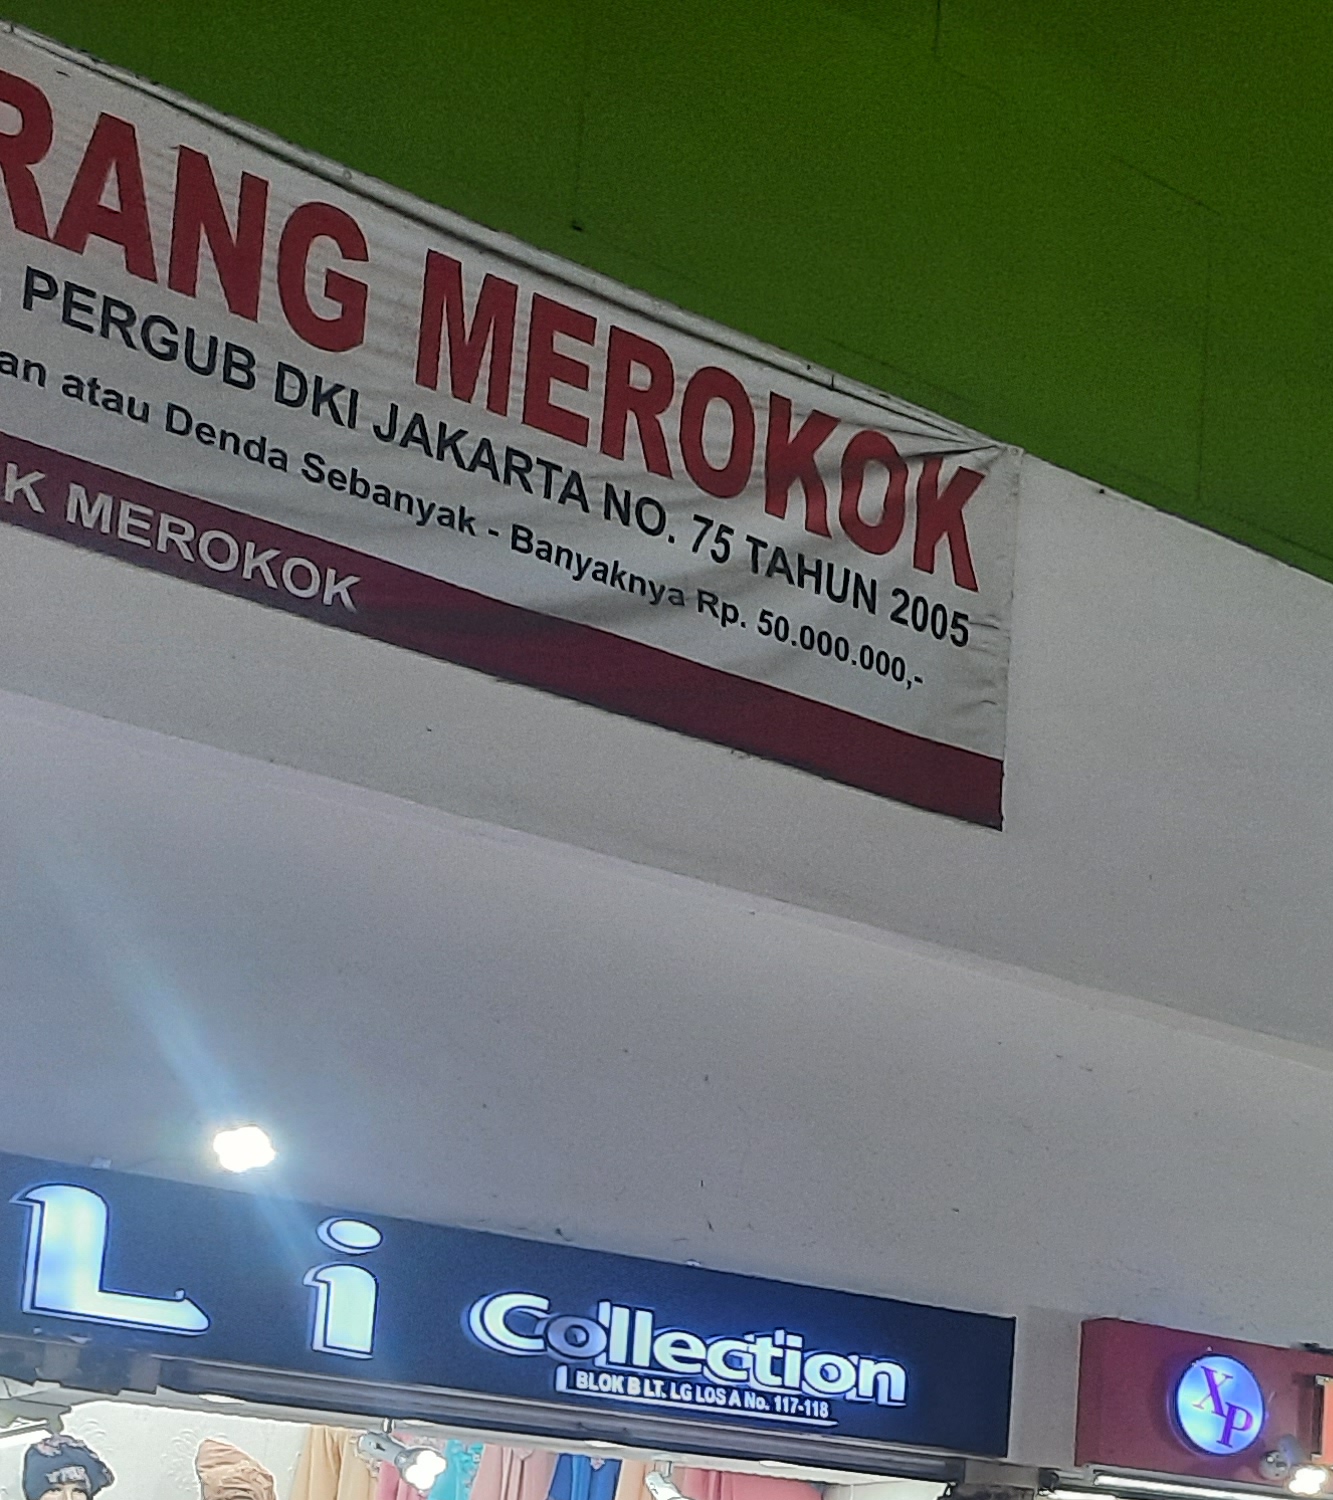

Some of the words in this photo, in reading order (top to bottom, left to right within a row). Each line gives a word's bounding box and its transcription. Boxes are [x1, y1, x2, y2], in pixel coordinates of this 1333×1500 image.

[22, 265, 258, 391] PERGUB
[273, 361, 360, 429] DKI
[373, 402, 590, 514] JAKARTA
[603, 481, 676, 544] NO.
[690, 513, 736, 564] 75
[745, 534, 878, 615] TAHUN
[890, 587, 970, 648] 2005
[61, 373, 150, 424] atau
[164, 402, 289, 472] Denda
[300, 451, 477, 537] Sebanyak
[509, 523, 685, 608] Banyaknya
[696, 588, 747, 629] Rp.
[756, 608, 924, 690] 50.000.000,-
[414, 247, 987, 592] MEROKOK
[65, 481, 362, 613] MEROKOK
[468, 1290, 908, 1407] Collection
[575, 1370, 624, 1395] BLOK
[626, 1375, 642, 1396] B
[643, 1379, 667, 1399] LT.
[669, 1381, 694, 1402] LG
[695, 1385, 727, 1406] LOS
[727, 1389, 743, 1409] A
[743, 1391, 770, 1412] No.
[773, 1394, 830, 1419] 117-118
